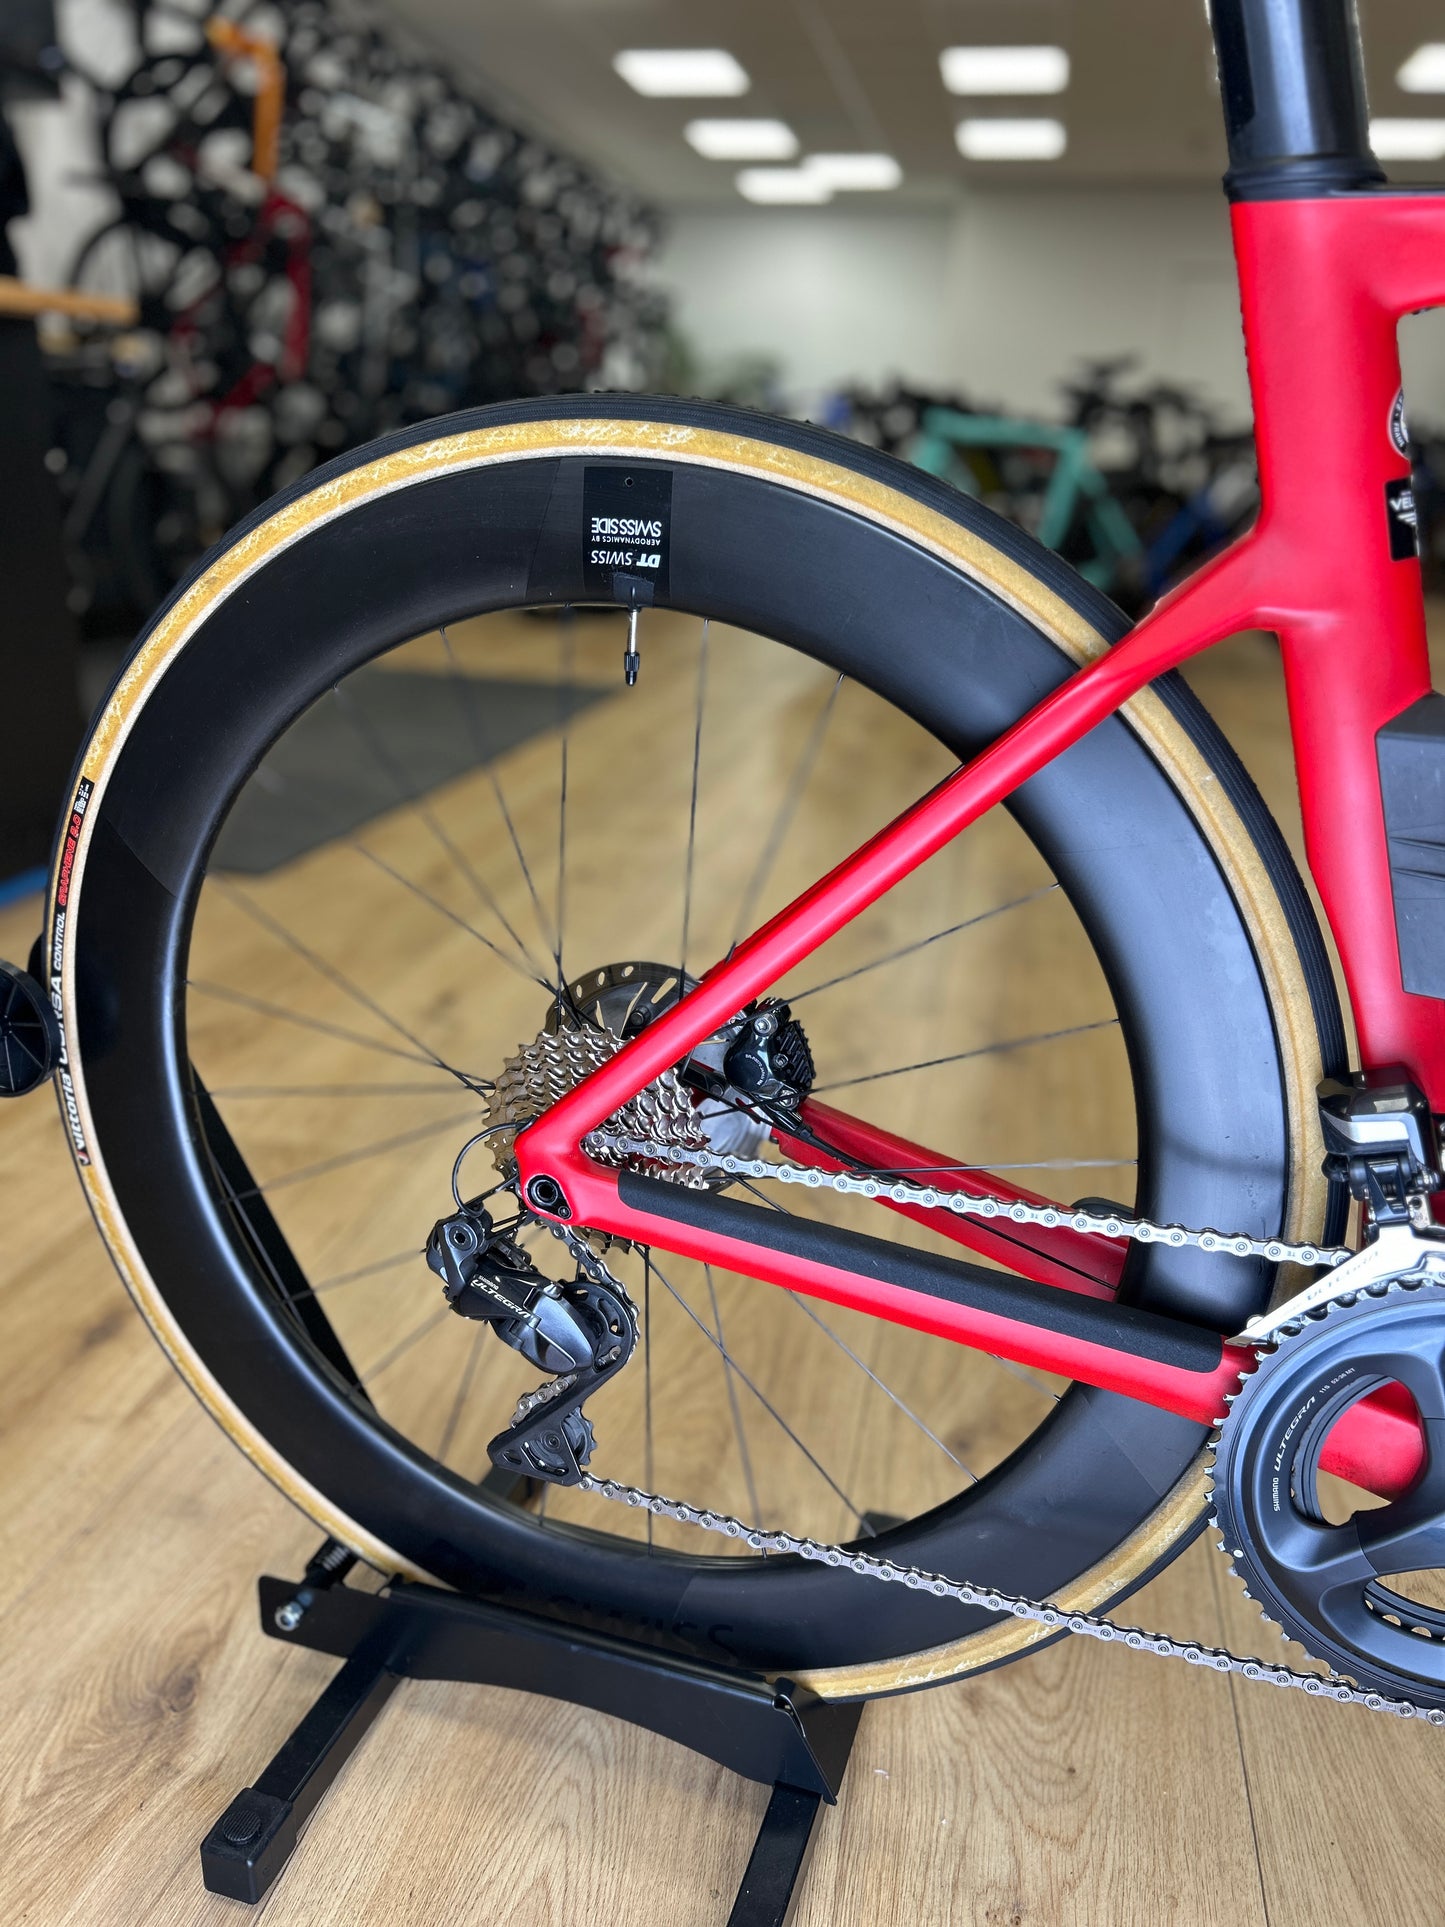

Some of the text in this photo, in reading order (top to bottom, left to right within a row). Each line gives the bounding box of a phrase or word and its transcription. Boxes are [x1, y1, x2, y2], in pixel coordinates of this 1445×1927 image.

[590, 550, 661, 568] DT SWISS
[602, 535, 661, 546] AERODYNAMICS
[58, 837, 77, 906] GRAPHENE
[53, 912, 66, 971] CONTROL
[470, 1279, 531, 1318] ULTEGRA
[1274, 1396, 1316, 1472] ULTEGRA
[1272, 1477, 1280, 1512] SHIMANO
